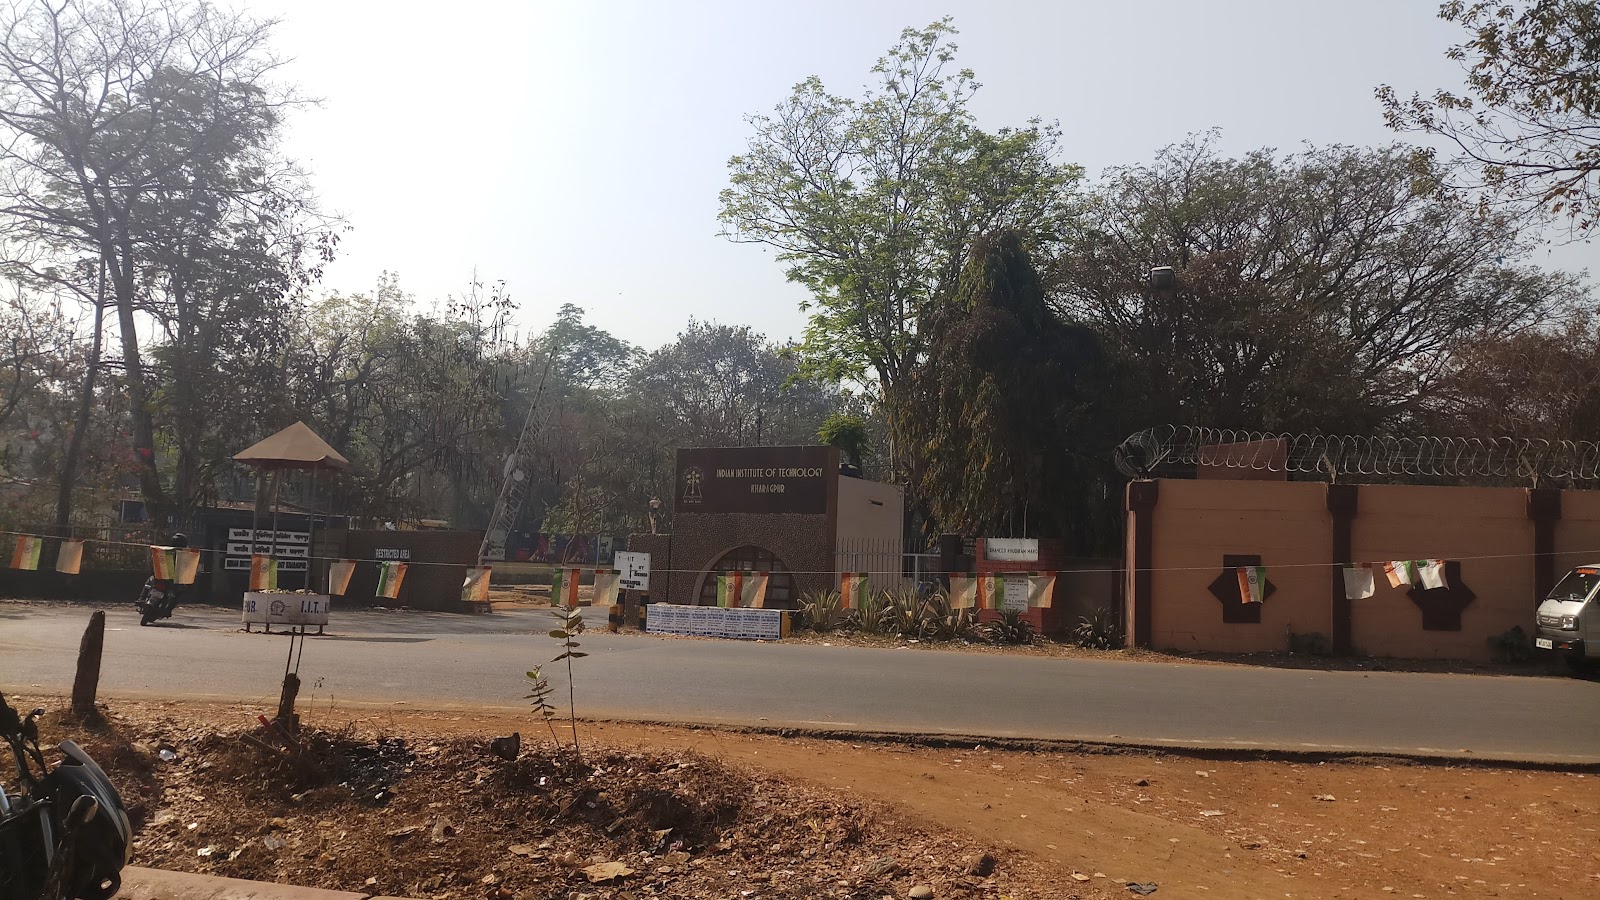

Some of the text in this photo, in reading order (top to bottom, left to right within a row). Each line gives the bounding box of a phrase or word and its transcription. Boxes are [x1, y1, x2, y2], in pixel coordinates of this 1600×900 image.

[716, 467, 823, 478] INDIAN INSTITUTE OF TECHNOLOGY
[750, 483, 785, 494] KHARAGPUR
[375, 548, 411, 559] RESTRICTED AREA
